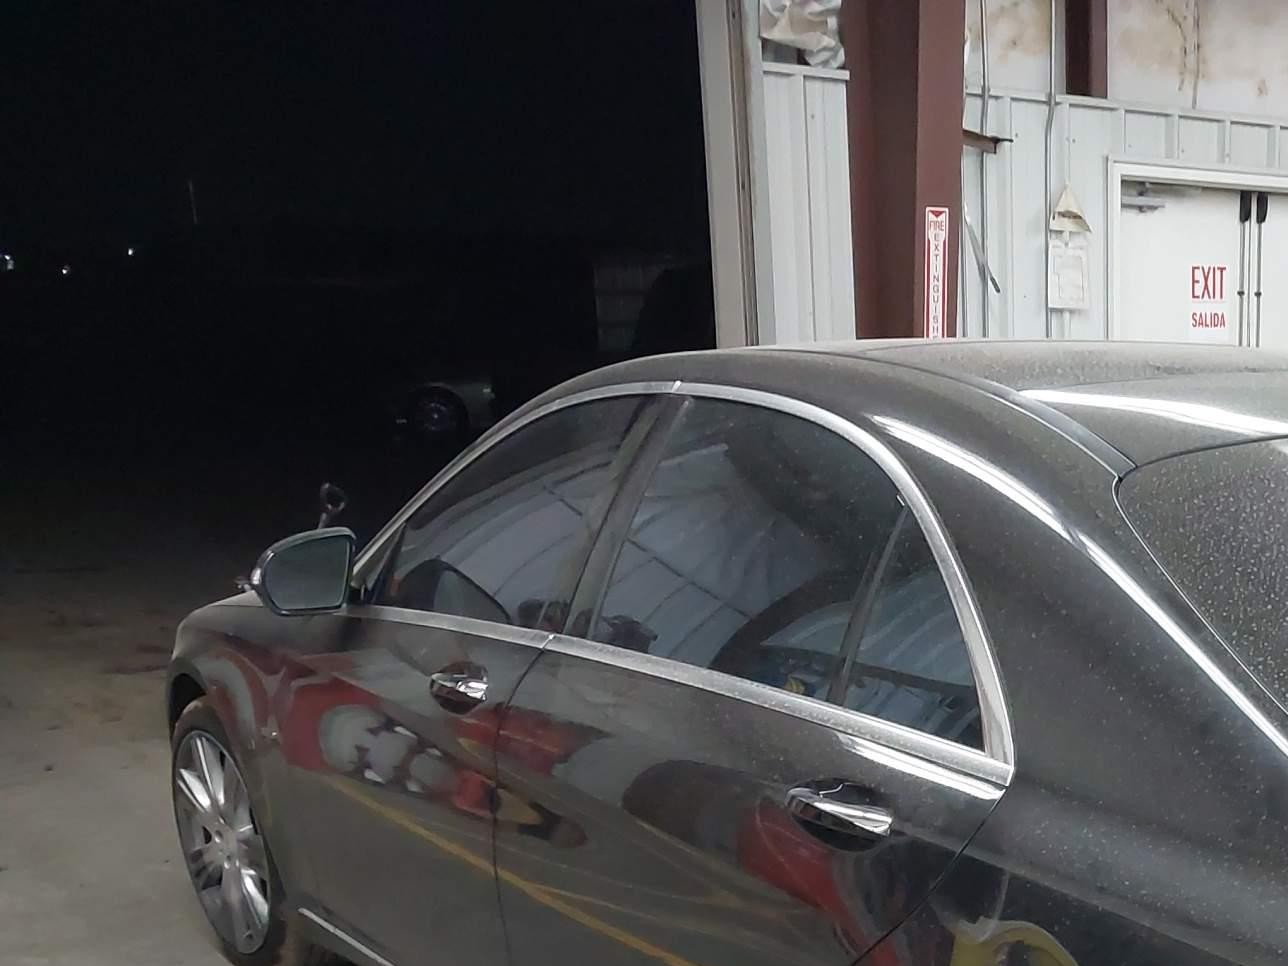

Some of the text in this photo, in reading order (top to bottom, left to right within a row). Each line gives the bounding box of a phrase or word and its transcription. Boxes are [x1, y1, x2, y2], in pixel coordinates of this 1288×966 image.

[929, 220, 945, 231] FIRE
[932, 232, 941, 338] EXTINGUISH
[1191, 266, 1227, 300] EXIT
[1191, 312, 1226, 328] SALIDA
